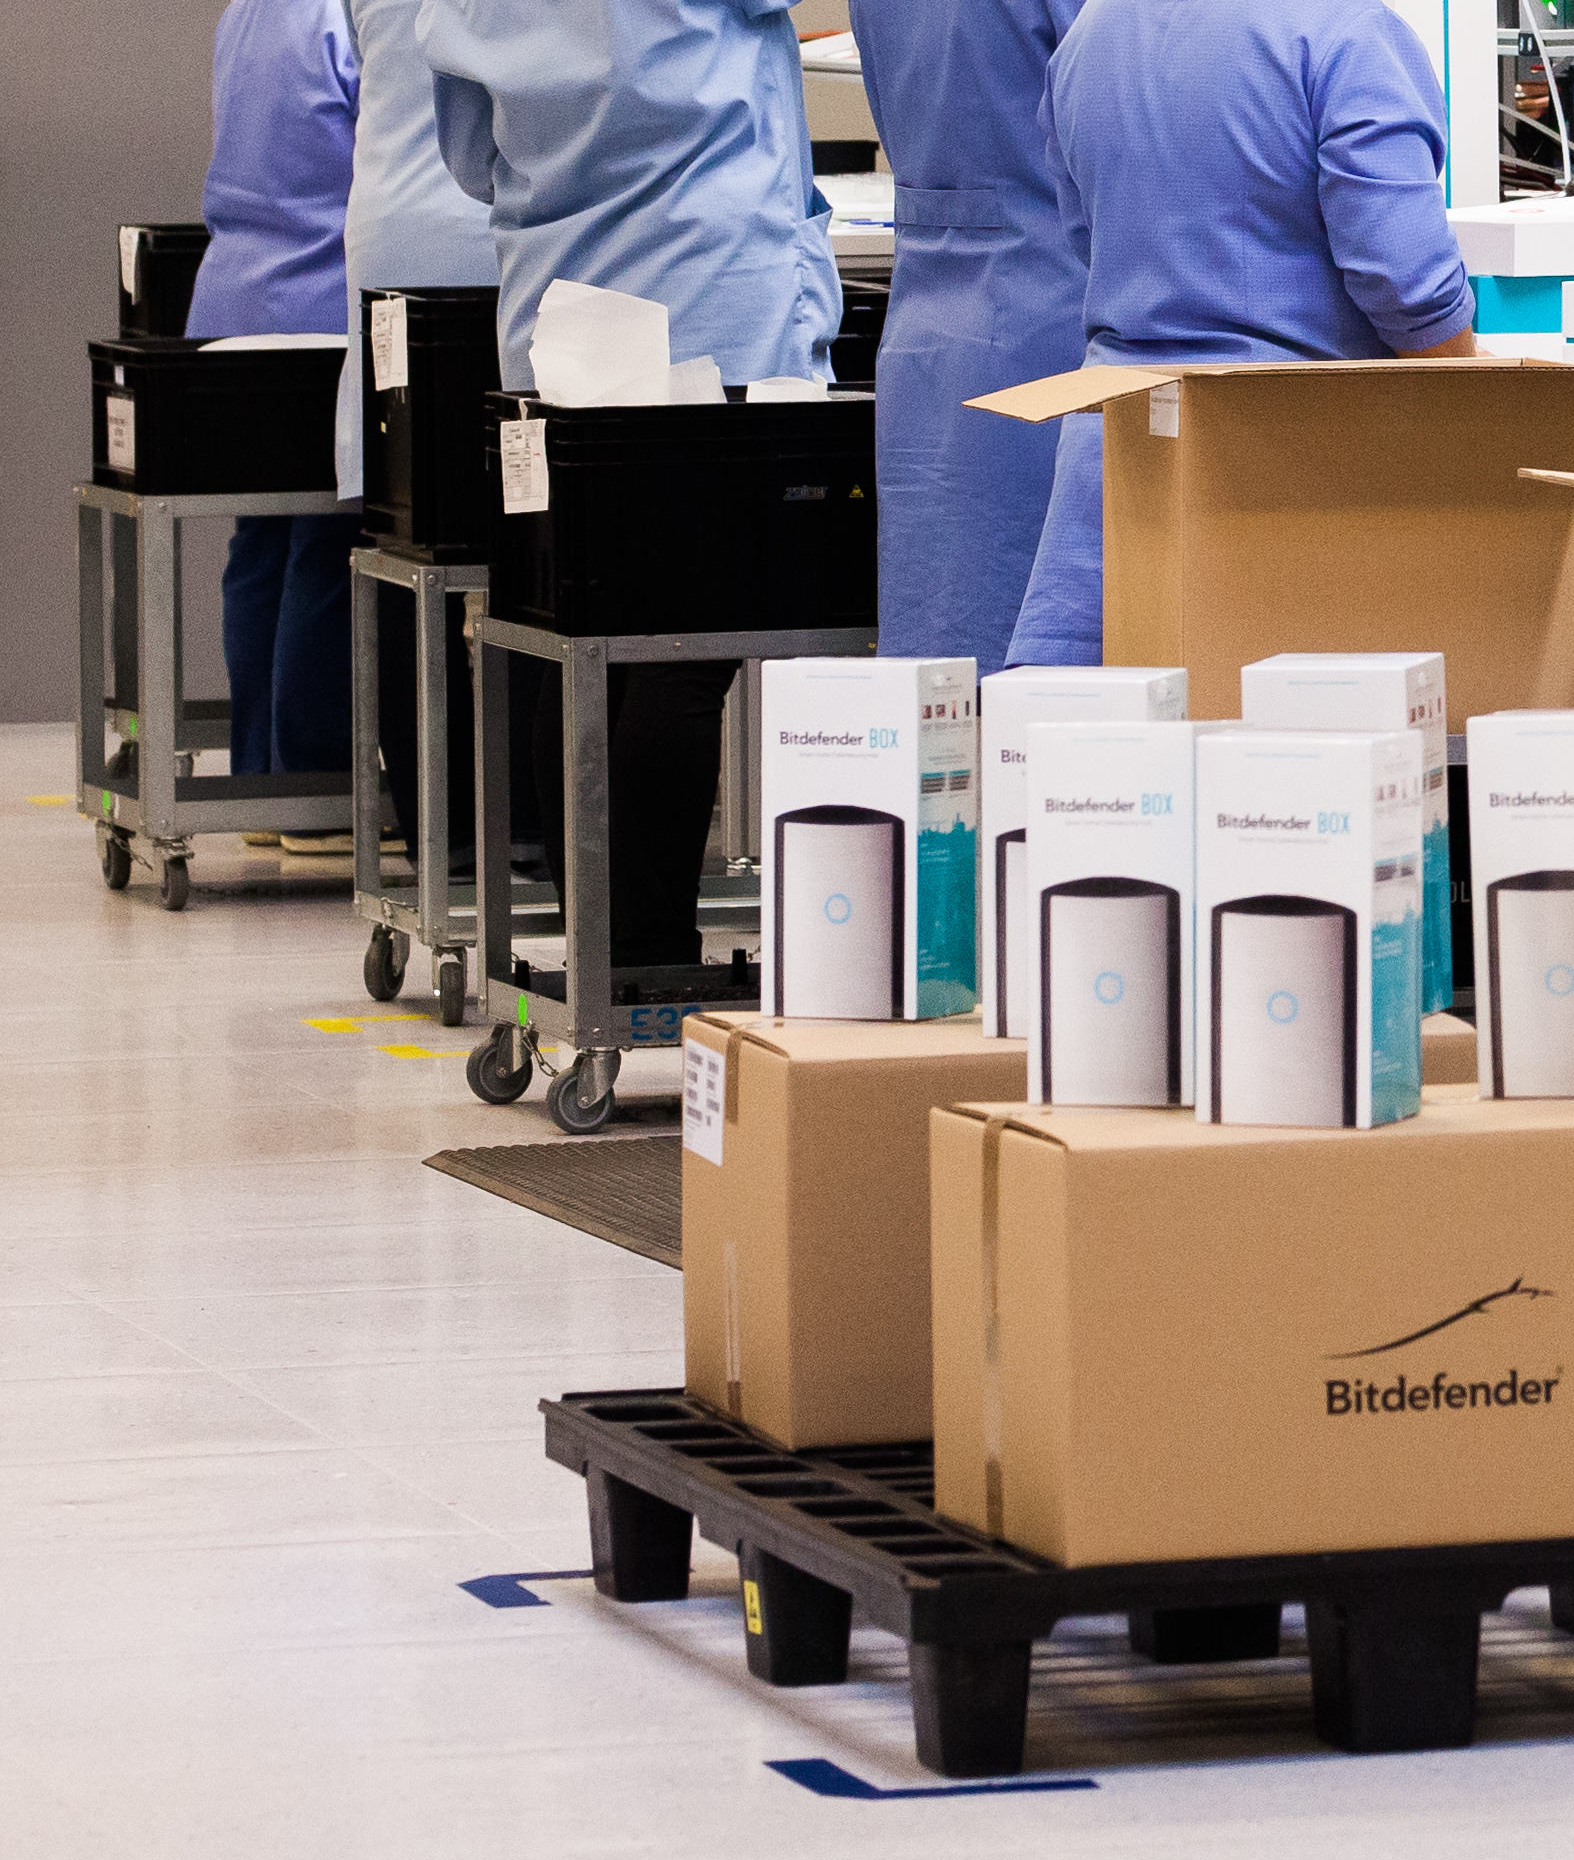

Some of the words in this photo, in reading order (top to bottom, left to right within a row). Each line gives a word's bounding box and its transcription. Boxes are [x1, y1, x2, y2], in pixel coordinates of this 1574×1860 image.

[780, 731, 864, 745] Bitdefender
[869, 728, 898, 748] BOX
[1045, 798, 1136, 813] Bitdefender
[1141, 793, 1173, 815] BOX
[1217, 813, 1311, 830] Bitdefender
[1317, 811, 1350, 834] BOX
[1325, 1369, 1559, 1415] Bitdefender
